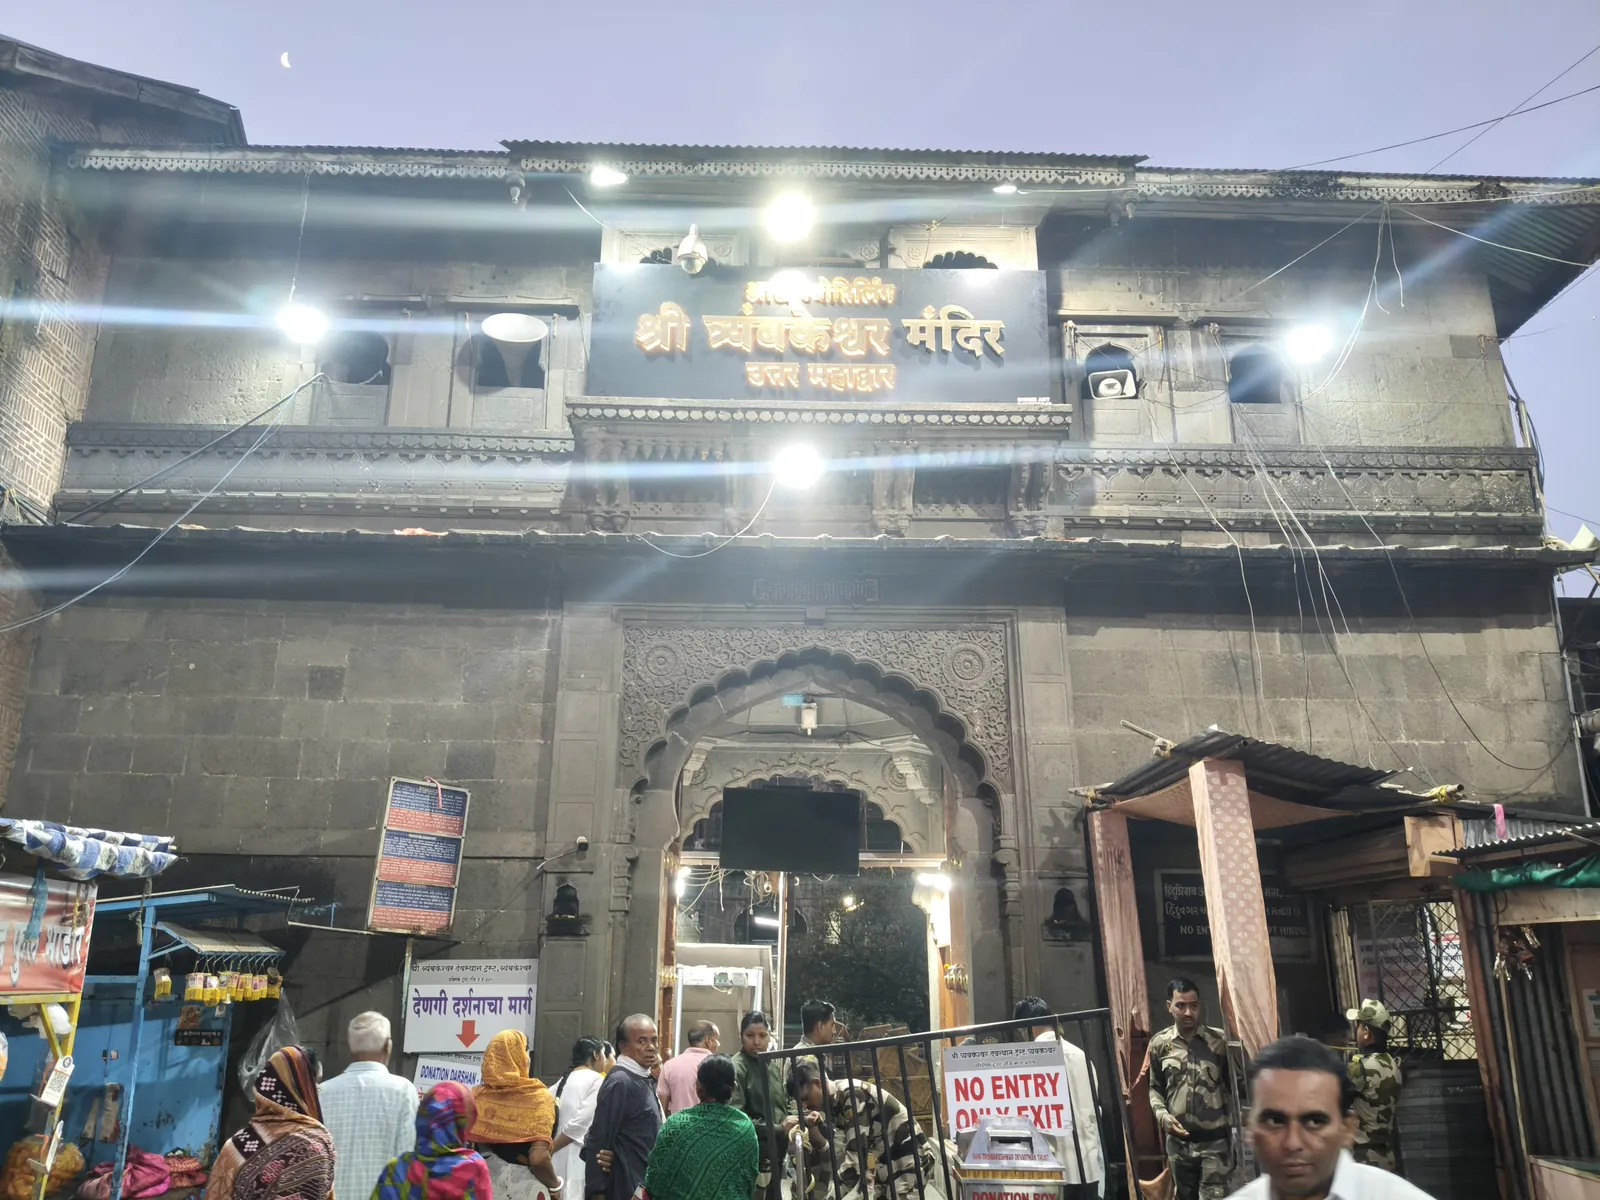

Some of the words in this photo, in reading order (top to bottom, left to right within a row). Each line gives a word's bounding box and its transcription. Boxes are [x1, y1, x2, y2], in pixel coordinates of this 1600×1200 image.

[635, 301, 691, 352] श्री
[901, 304, 1006, 358] मंदिर
[1180, 925, 1194, 935] NO
[412, 987, 448, 1018] देणगी
[452, 987, 503, 1018] दर्शनाचा
[508, 986, 533, 1016] मार्ग
[420, 1065, 450, 1081] DONATION
[450, 1069, 477, 1085] DARSHAN
[954, 1077, 985, 1102] NO
[990, 1072, 1060, 1100] ENTRY
